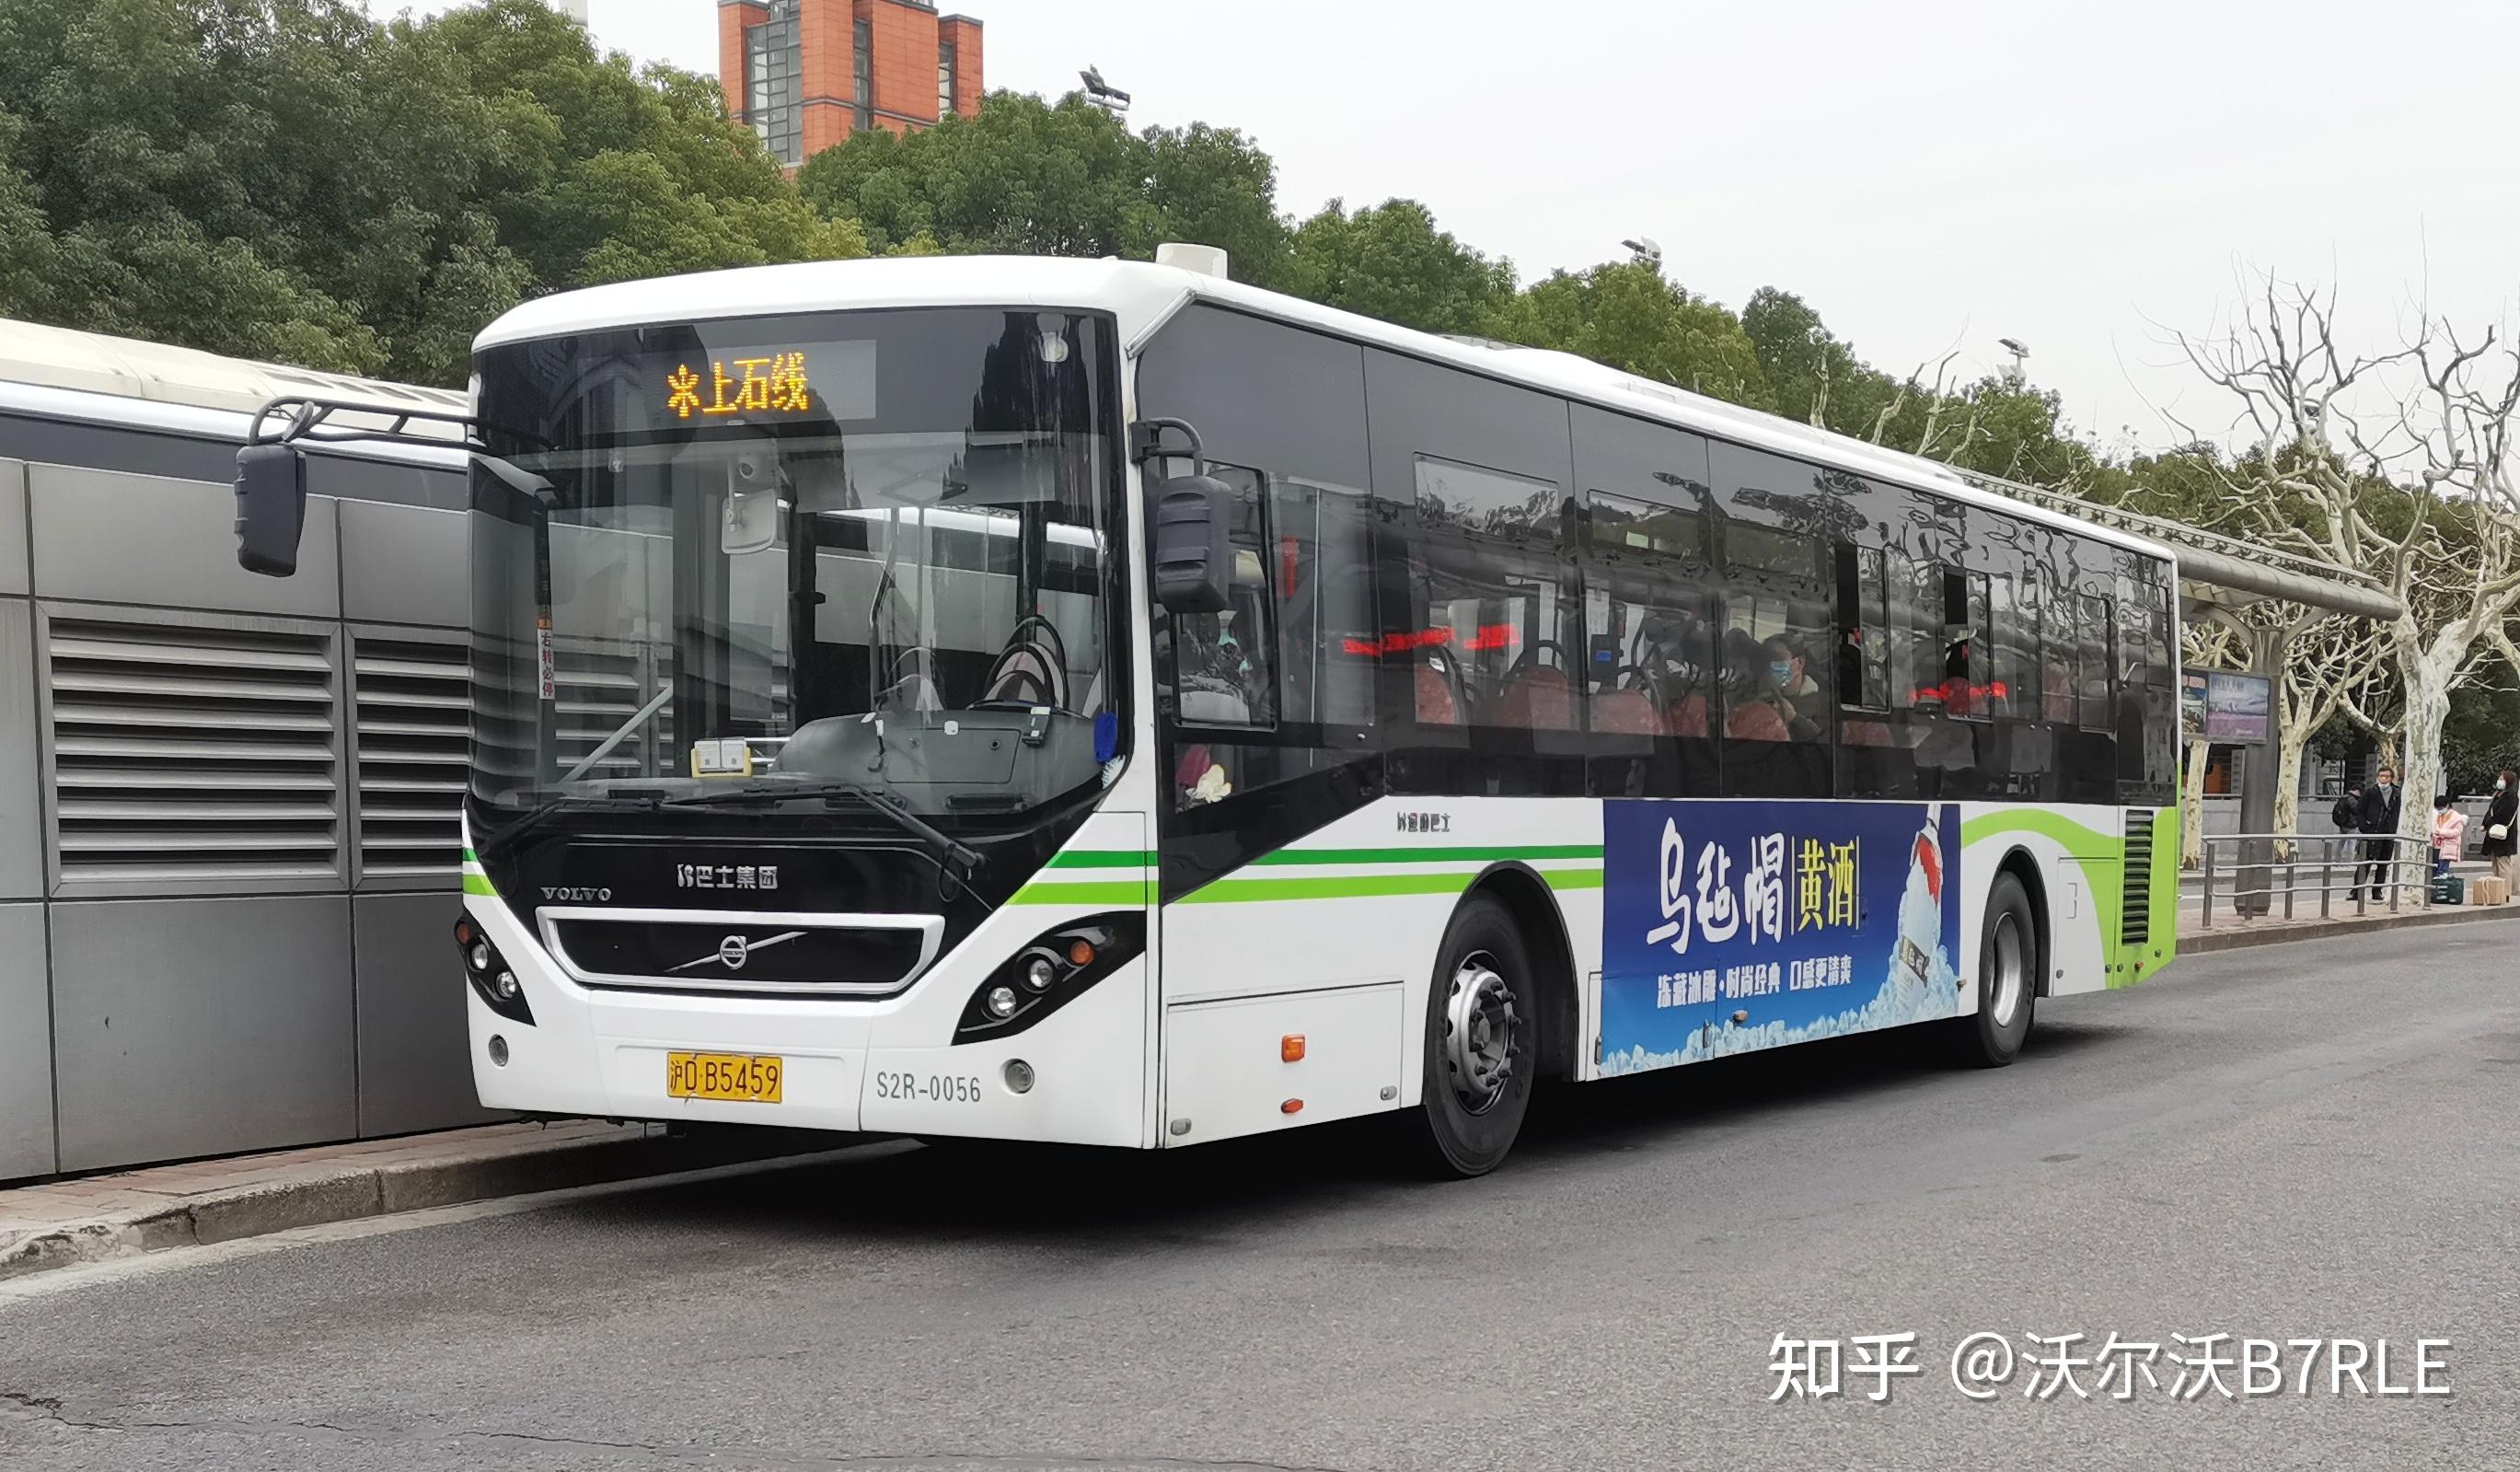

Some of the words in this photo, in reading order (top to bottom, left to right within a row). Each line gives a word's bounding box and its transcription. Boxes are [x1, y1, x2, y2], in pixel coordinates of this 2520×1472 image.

[702, 353, 809, 412] 上石线
[540, 632, 553, 697] 右转必停
[540, 887, 612, 901] VOLVO
[1647, 817, 1785, 955] 乌毡帽
[1797, 839, 1855, 932] 黄酒
[1789, 954, 1852, 991] 口感更清爽
[876, 1072, 982, 1103] S2R-0056
